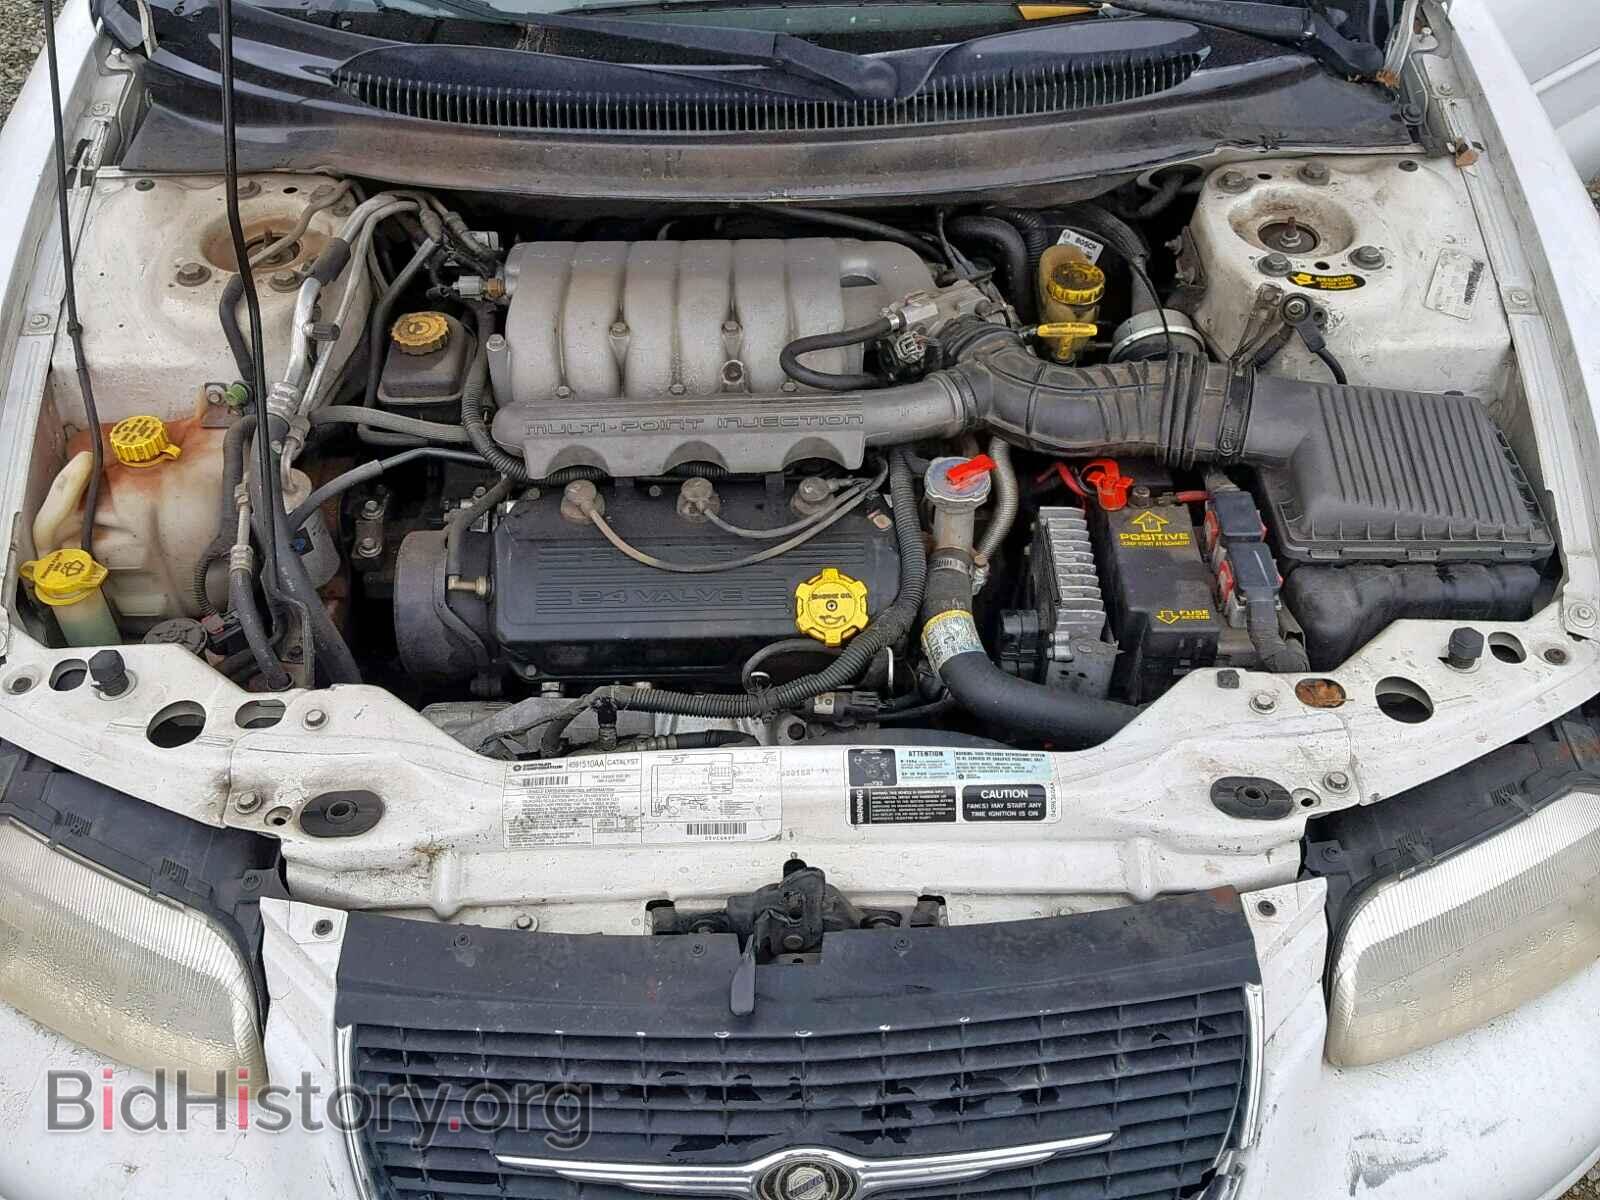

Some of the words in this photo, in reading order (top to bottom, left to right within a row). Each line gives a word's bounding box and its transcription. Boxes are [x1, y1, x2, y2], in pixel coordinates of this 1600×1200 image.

[1075, 237, 1097, 249] BOSCH
[527, 417, 704, 435] MULTI-POINT
[716, 414, 865, 429] INJECTION
[1120, 533, 1190, 541] POSITIVE
[577, 588, 626, 604] 24
[633, 588, 745, 602] VALVE
[607, 758, 641, 766] CATALYST
[980, 789, 1029, 799] CAUTION
[855, 789, 865, 824] WARNING
